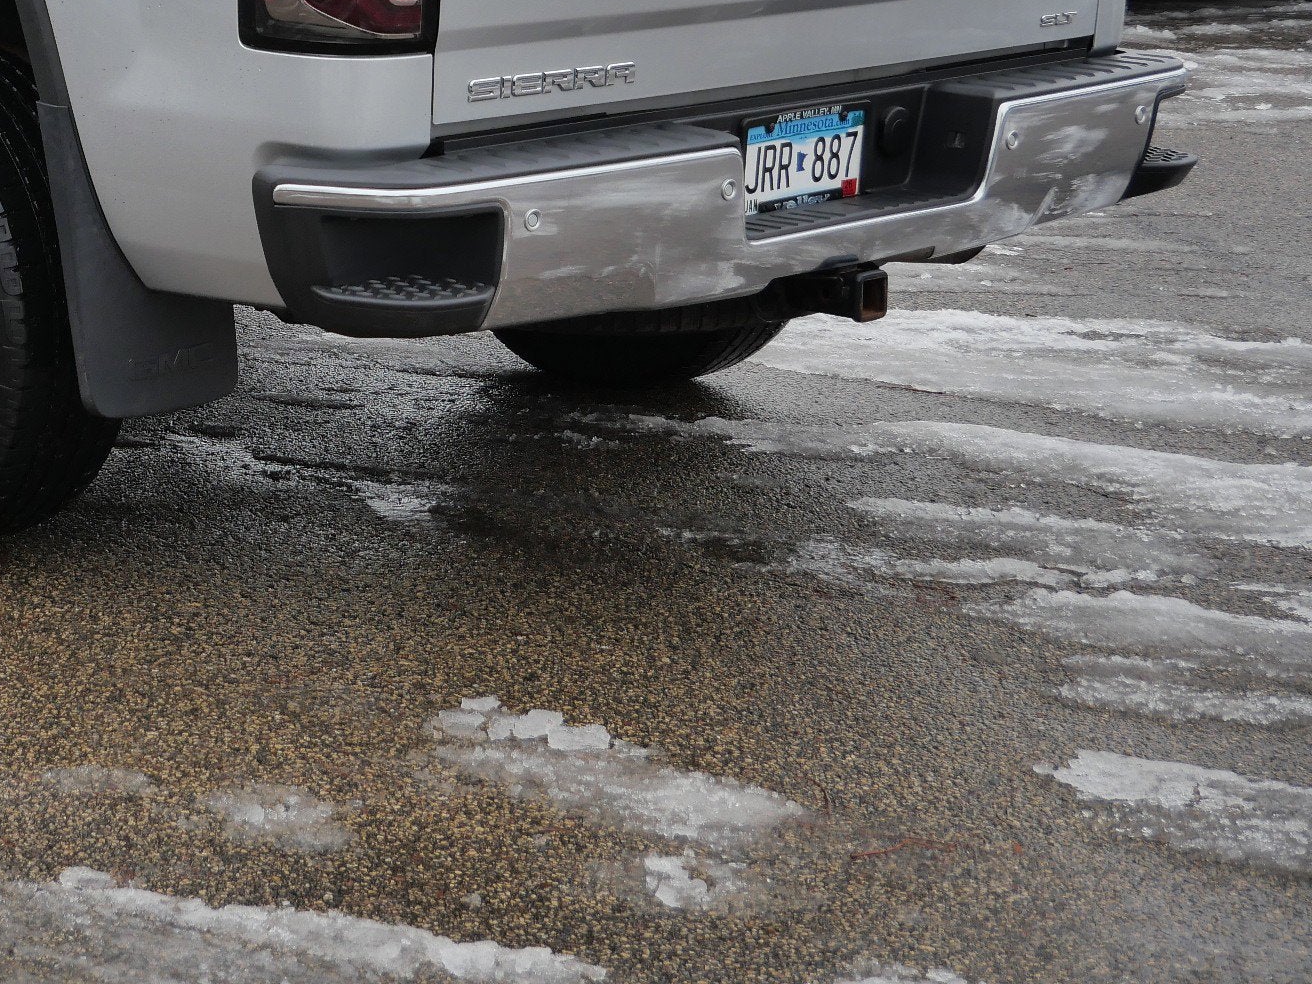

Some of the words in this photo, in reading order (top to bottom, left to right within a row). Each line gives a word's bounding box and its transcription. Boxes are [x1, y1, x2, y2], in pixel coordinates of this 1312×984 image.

[1040, 11, 1077, 27] SLT
[468, 62, 636, 103] SIERRA
[776, 111, 801, 123] APPLE
[831, 104, 842, 115] MN
[745, 141, 793, 195] JRR
[811, 130, 859, 183] 887
[745, 199, 758, 213] JAN
